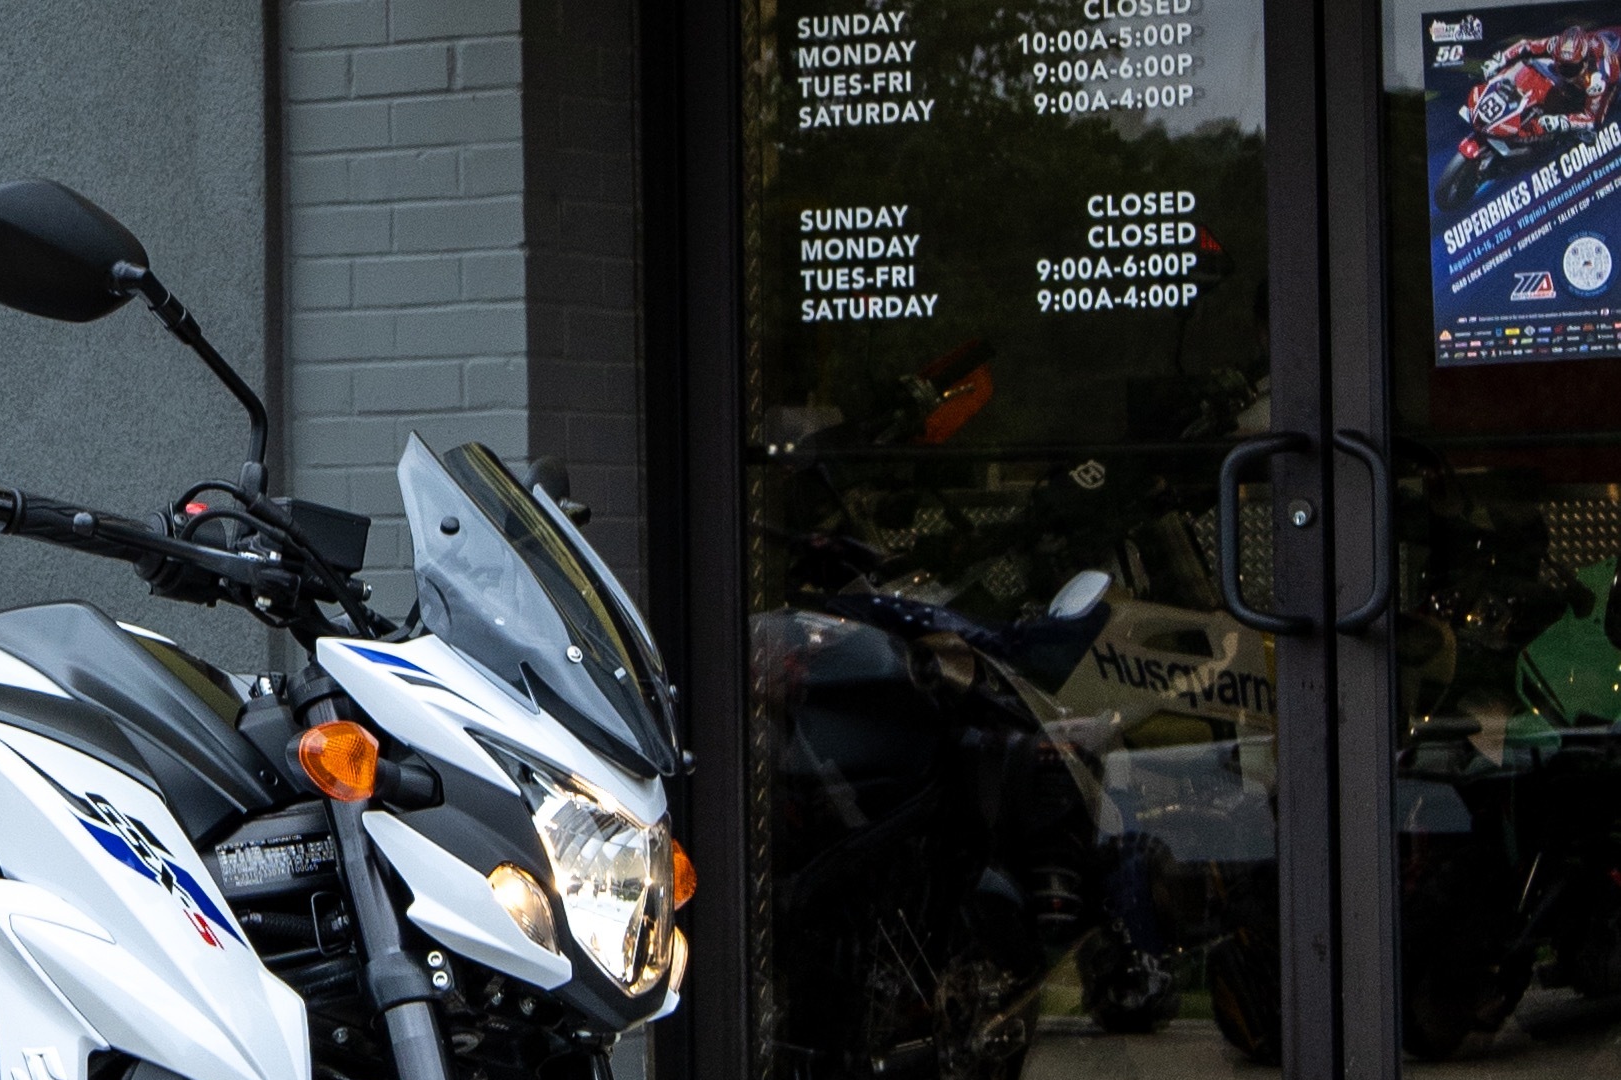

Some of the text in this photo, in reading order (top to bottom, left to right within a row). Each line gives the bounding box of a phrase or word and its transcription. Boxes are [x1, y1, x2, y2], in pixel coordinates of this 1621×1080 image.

[798, 0, 1190, 39] SUNDAY CLOSED
[798, 23, 1193, 69] MONDAY 10:00A-5:00P
[798, 54, 1193, 99] TUES-FRI 9:00A-6:00P
[799, 85, 1194, 129] SATURDAY 9:00A-4:00P
[1444, 122, 1621, 255] SUPERBIKES ARE COMING
[800, 192, 1196, 232] SUNDAY CLOSED
[1449, 252, 1473, 275] August
[1592, 155, 1621, 181] Racewa
[801, 222, 1196, 262] MONDAY CLOSED
[801, 253, 1197, 292] TUES-FRI 9:00A-6:00P
[801, 284, 1198, 322] SATURDAY 9:00A-4:00P
[1093, 642, 1275, 712] Husqvarn
